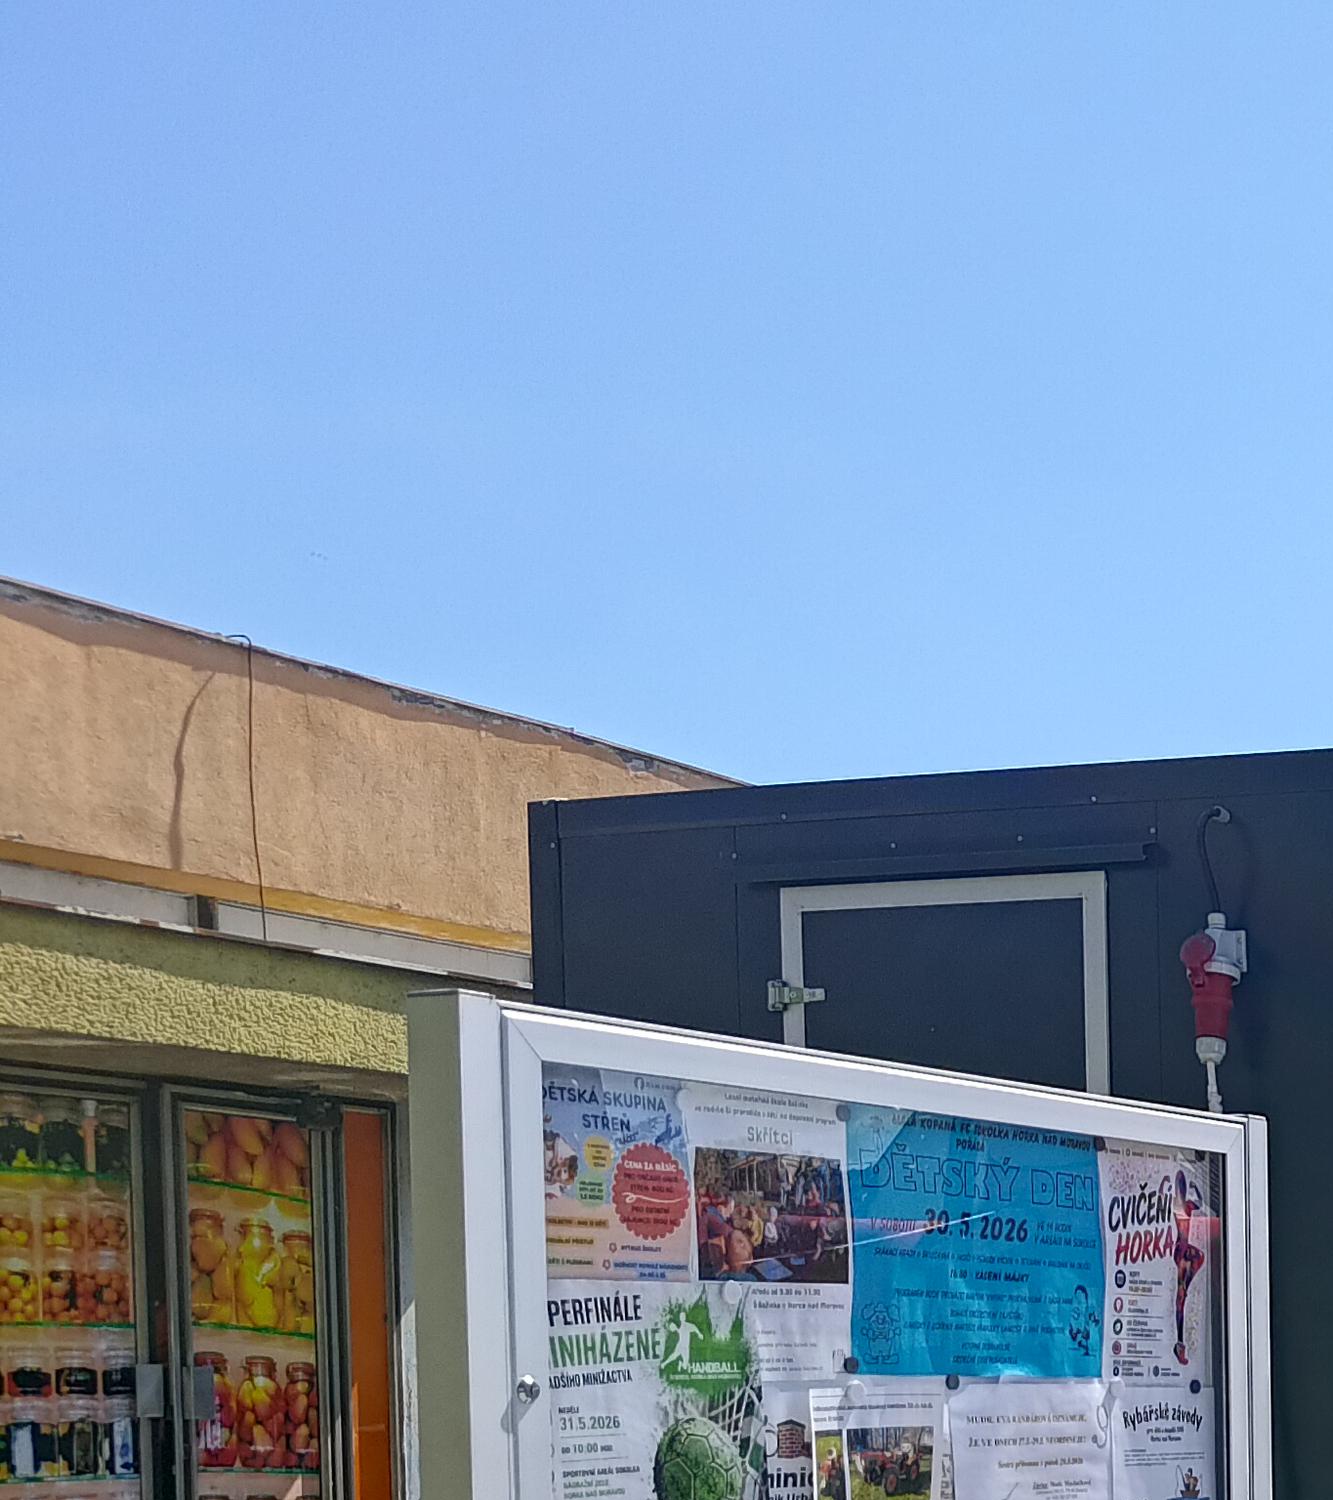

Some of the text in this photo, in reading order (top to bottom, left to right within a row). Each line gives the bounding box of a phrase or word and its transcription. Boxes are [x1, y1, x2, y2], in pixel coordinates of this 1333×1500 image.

[602, 1091, 667, 1113] SKUPINA
[582, 1110, 631, 1133] STŘEŇ
[747, 1126, 793, 1146] Skřítci
[920, 1117, 957, 1133] KOPANÁ
[960, 1122, 970, 1133] FC
[1012, 1128, 1040, 1143] HORKA
[1042, 1134, 1058, 1146] NAD
[859, 1142, 1095, 1212] DĚTSKÝ DEN
[1108, 1182, 1174, 1233] CVIČENÍ
[870, 1216, 878, 1231] V
[979, 1214, 1028, 1243] 2026
[1115, 1225, 1174, 1266] HORKA
[548, 1290, 643, 1327] PERFINÁLE
[549, 1323, 661, 1369] INIHÁZENÉ
[582, 1368, 633, 1386] MINIŽACTVA
[688, 1361, 742, 1373] HANDBALL
[560, 1415, 621, 1431] 31.5.2026
[1122, 1401, 1203, 1432] Rybářské závody
